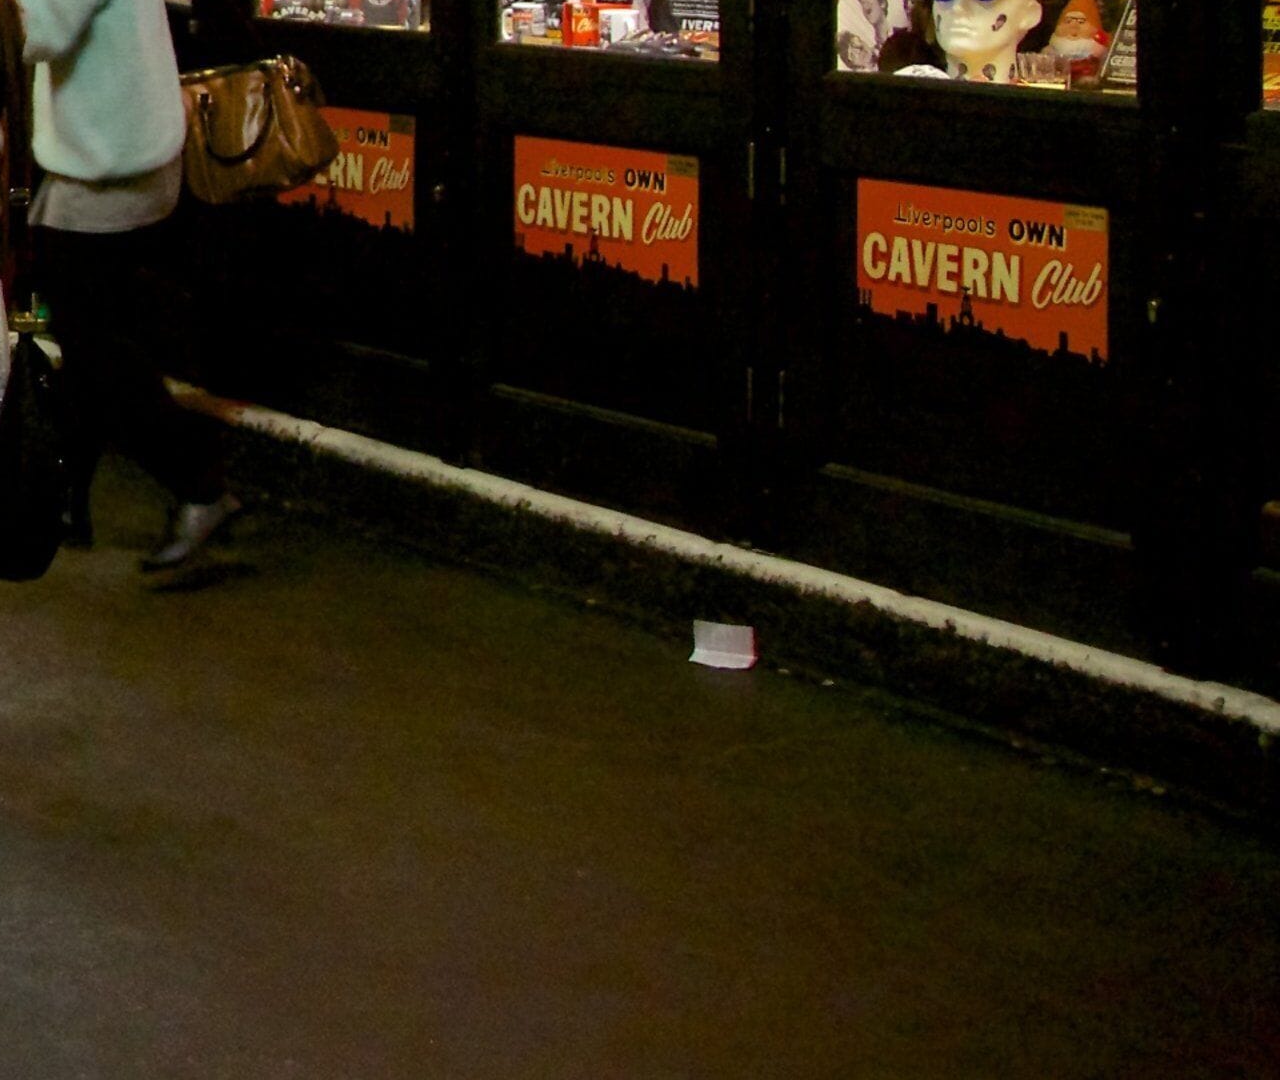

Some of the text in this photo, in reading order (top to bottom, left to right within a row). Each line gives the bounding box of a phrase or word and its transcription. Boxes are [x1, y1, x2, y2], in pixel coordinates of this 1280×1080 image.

[369, 156, 410, 195] Club
[623, 168, 667, 195] OWN
[516, 182, 693, 246] CAVERN Club
[893, 200, 1068, 252] Liverpools OWN
[862, 231, 1103, 310] CAVERN Club
